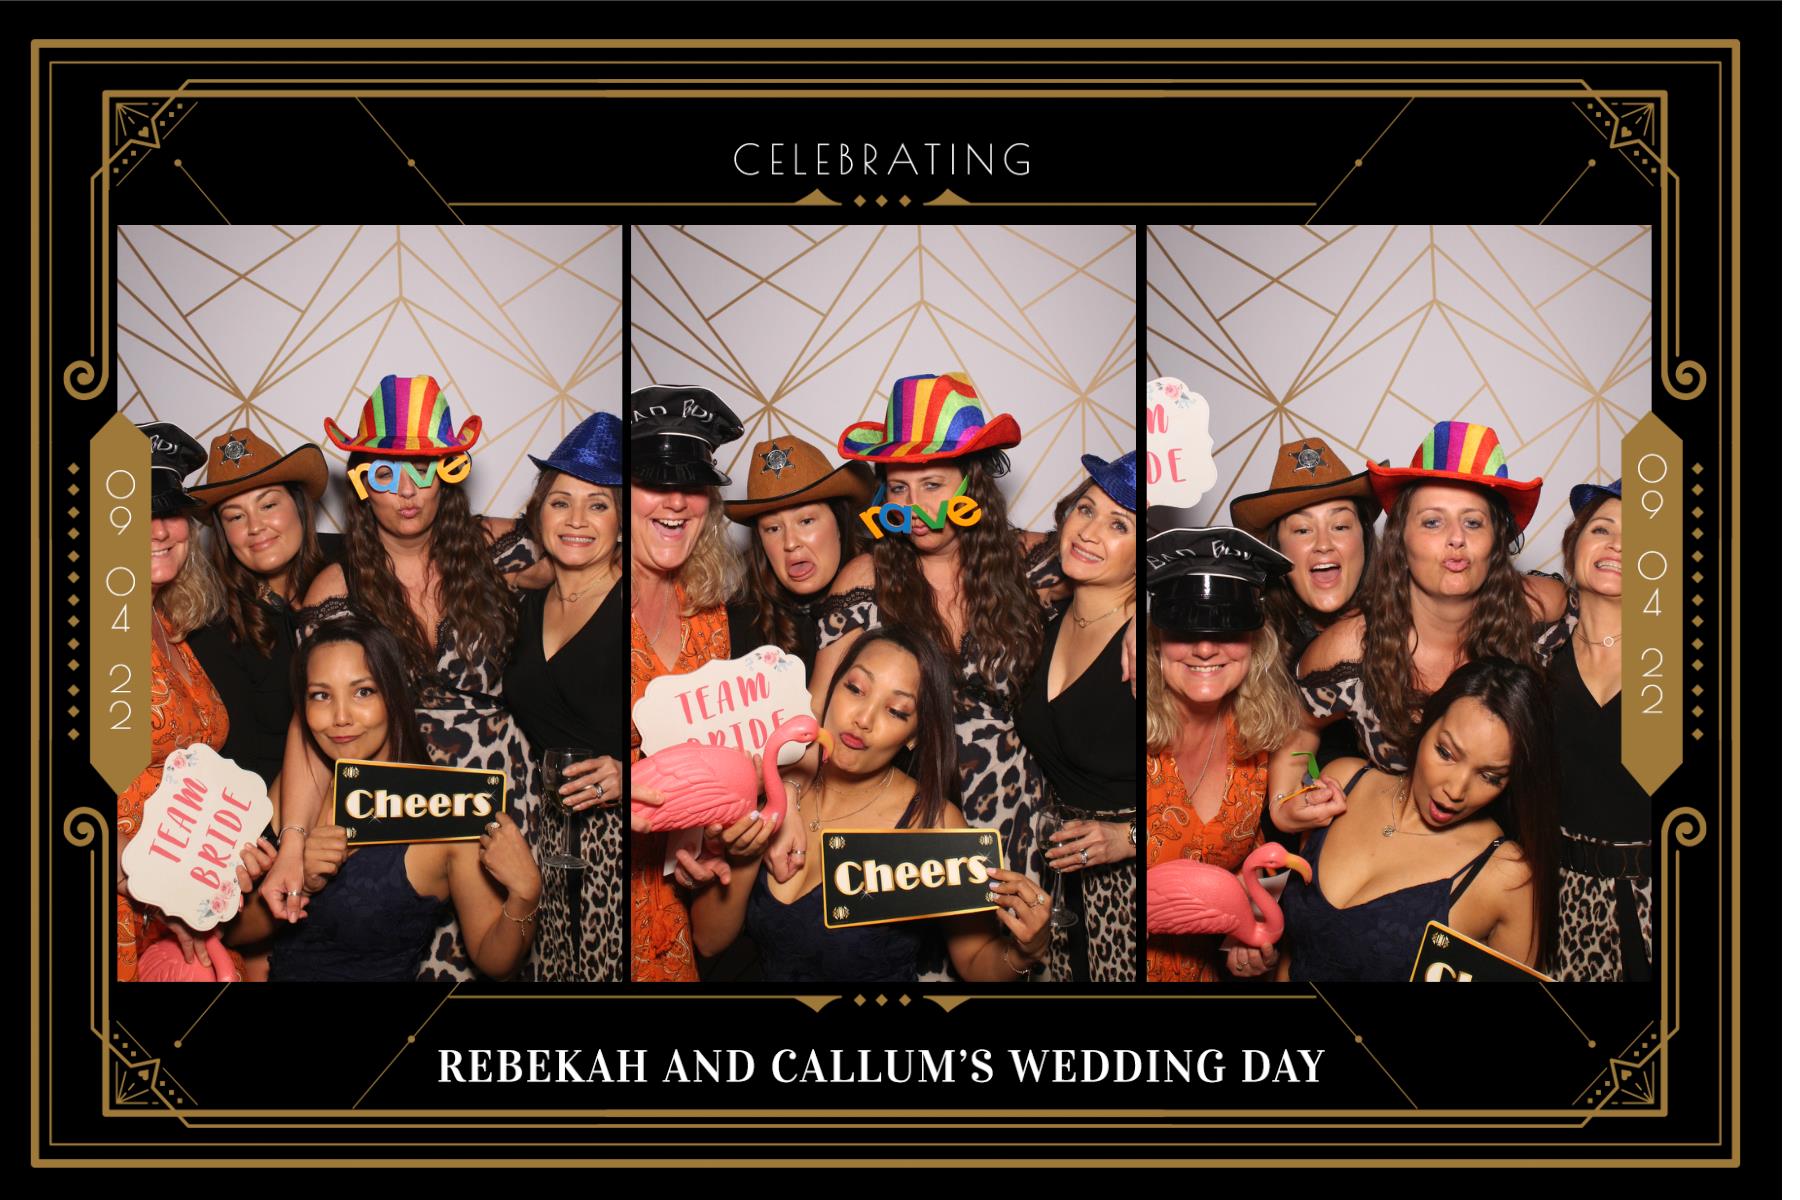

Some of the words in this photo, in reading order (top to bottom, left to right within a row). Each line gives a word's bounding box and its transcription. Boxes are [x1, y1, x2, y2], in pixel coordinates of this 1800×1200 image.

[630, 405, 667, 424] AD
[347, 454, 471, 500] rave
[859, 495, 982, 540] rave
[674, 672, 770, 725] TEAM
[686, 708, 785, 751] RIDE
[148, 777, 208, 863] TEAM
[344, 788, 493, 820] Cheers
[190, 786, 252, 890] BRIDE
[834, 854, 990, 896] Cheers
